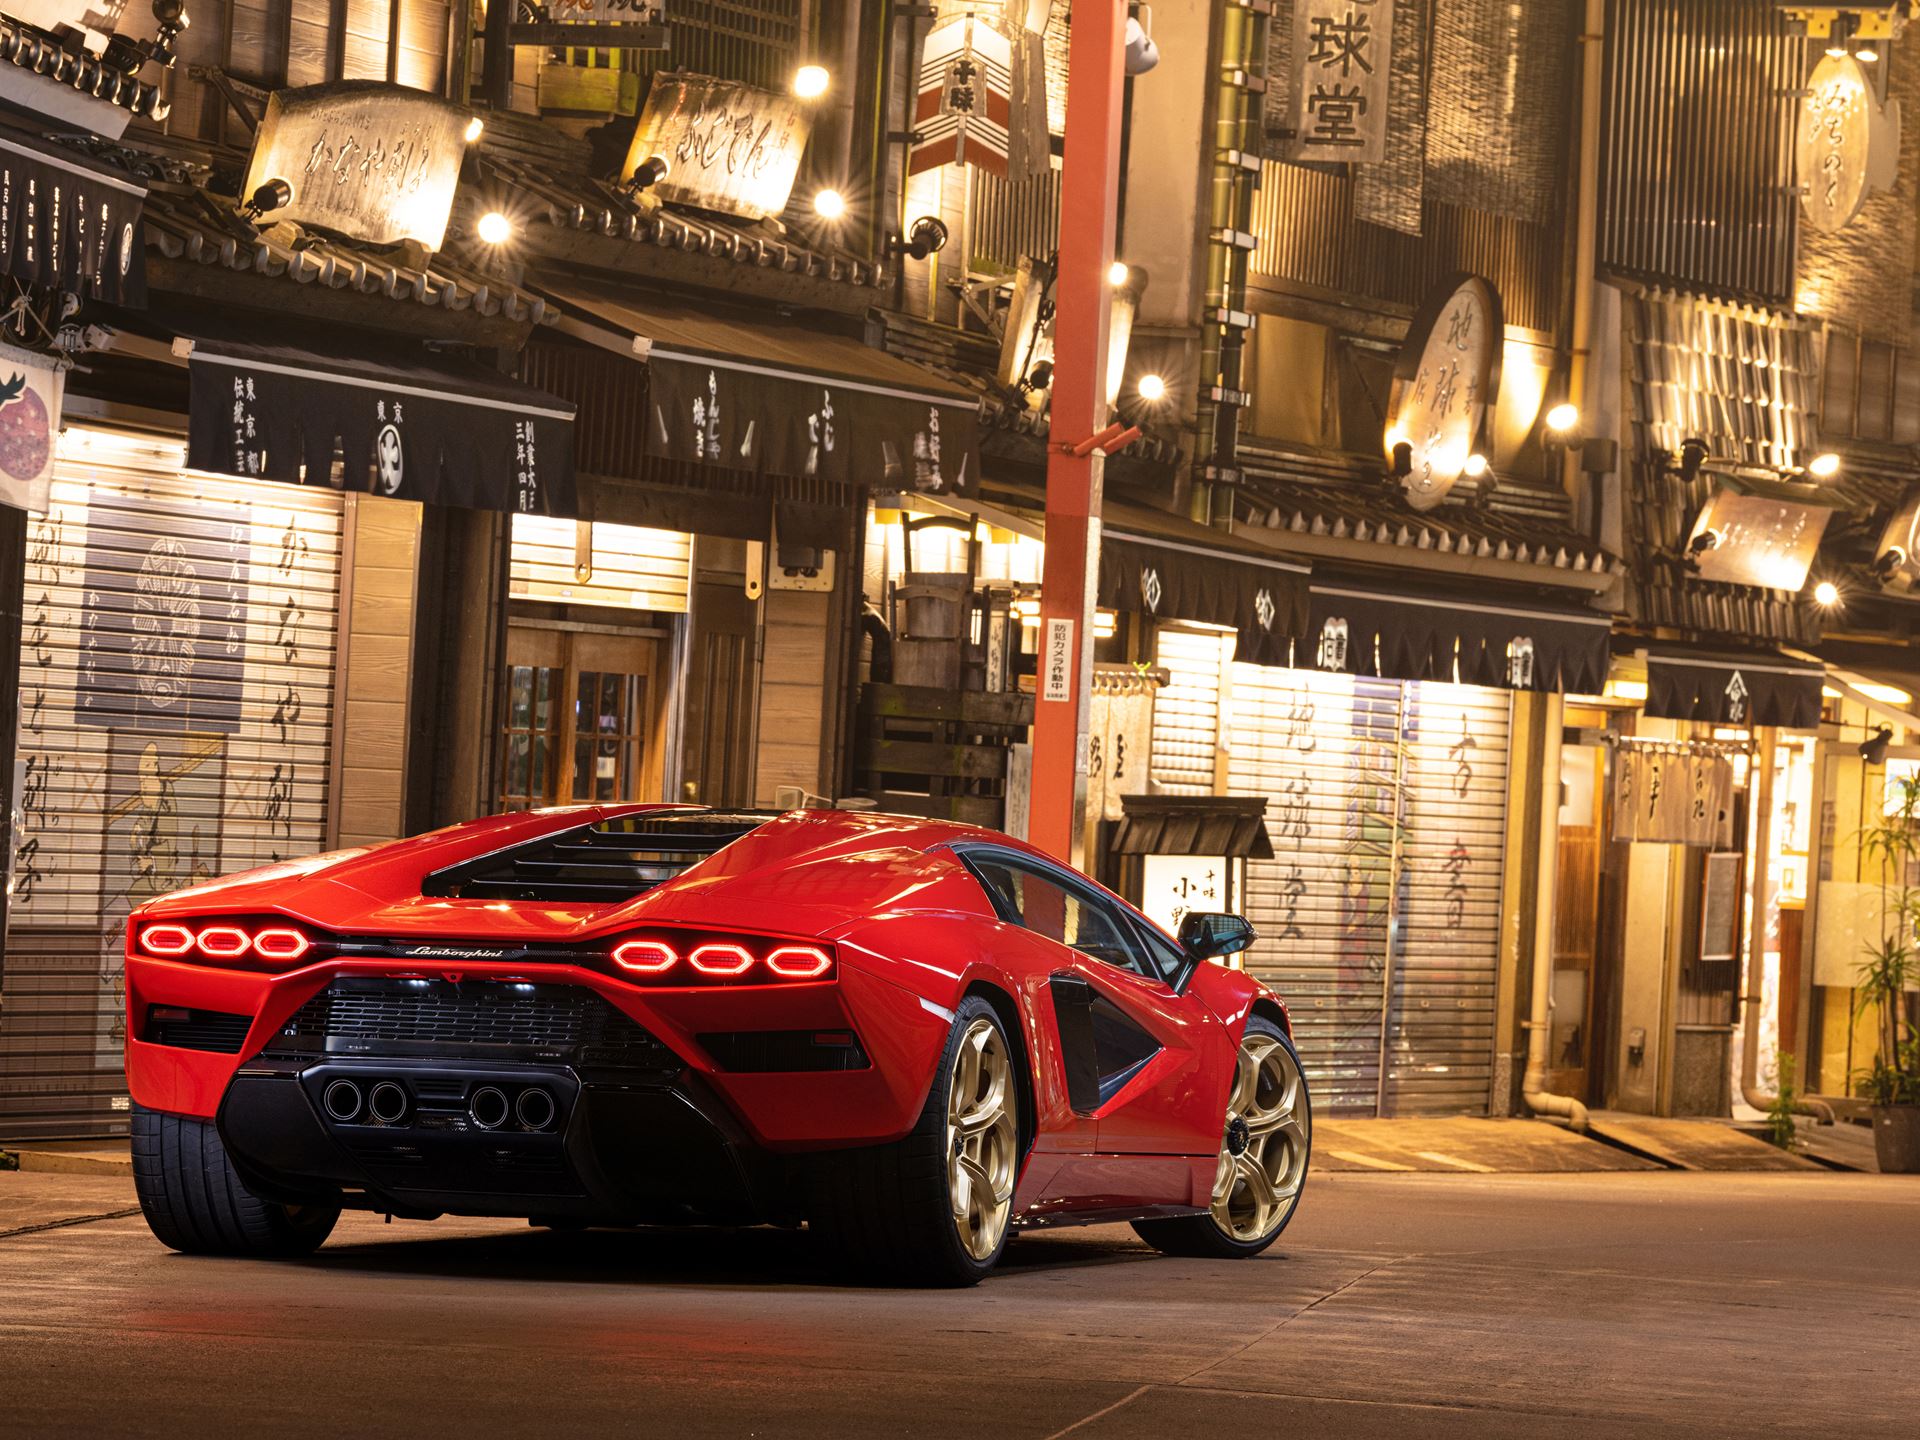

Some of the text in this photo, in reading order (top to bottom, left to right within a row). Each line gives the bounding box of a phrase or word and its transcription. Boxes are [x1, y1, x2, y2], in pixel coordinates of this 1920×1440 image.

[952, 60, 976, 113] 十味
[1303, 0, 1374, 147] 球堂
[1823, 83, 1848, 208] みちのく
[233, 375, 246, 473] 伝統工芸
[245, 376, 259, 475] 東京都
[376, 399, 403, 424] 東京
[515, 422, 527, 512] 三年四月
[263, 512, 310, 867] かなや刷
[1050, 623, 1067, 691] 防犯カメラ作動中
[405, 945, 504, 959] Lamborghini
